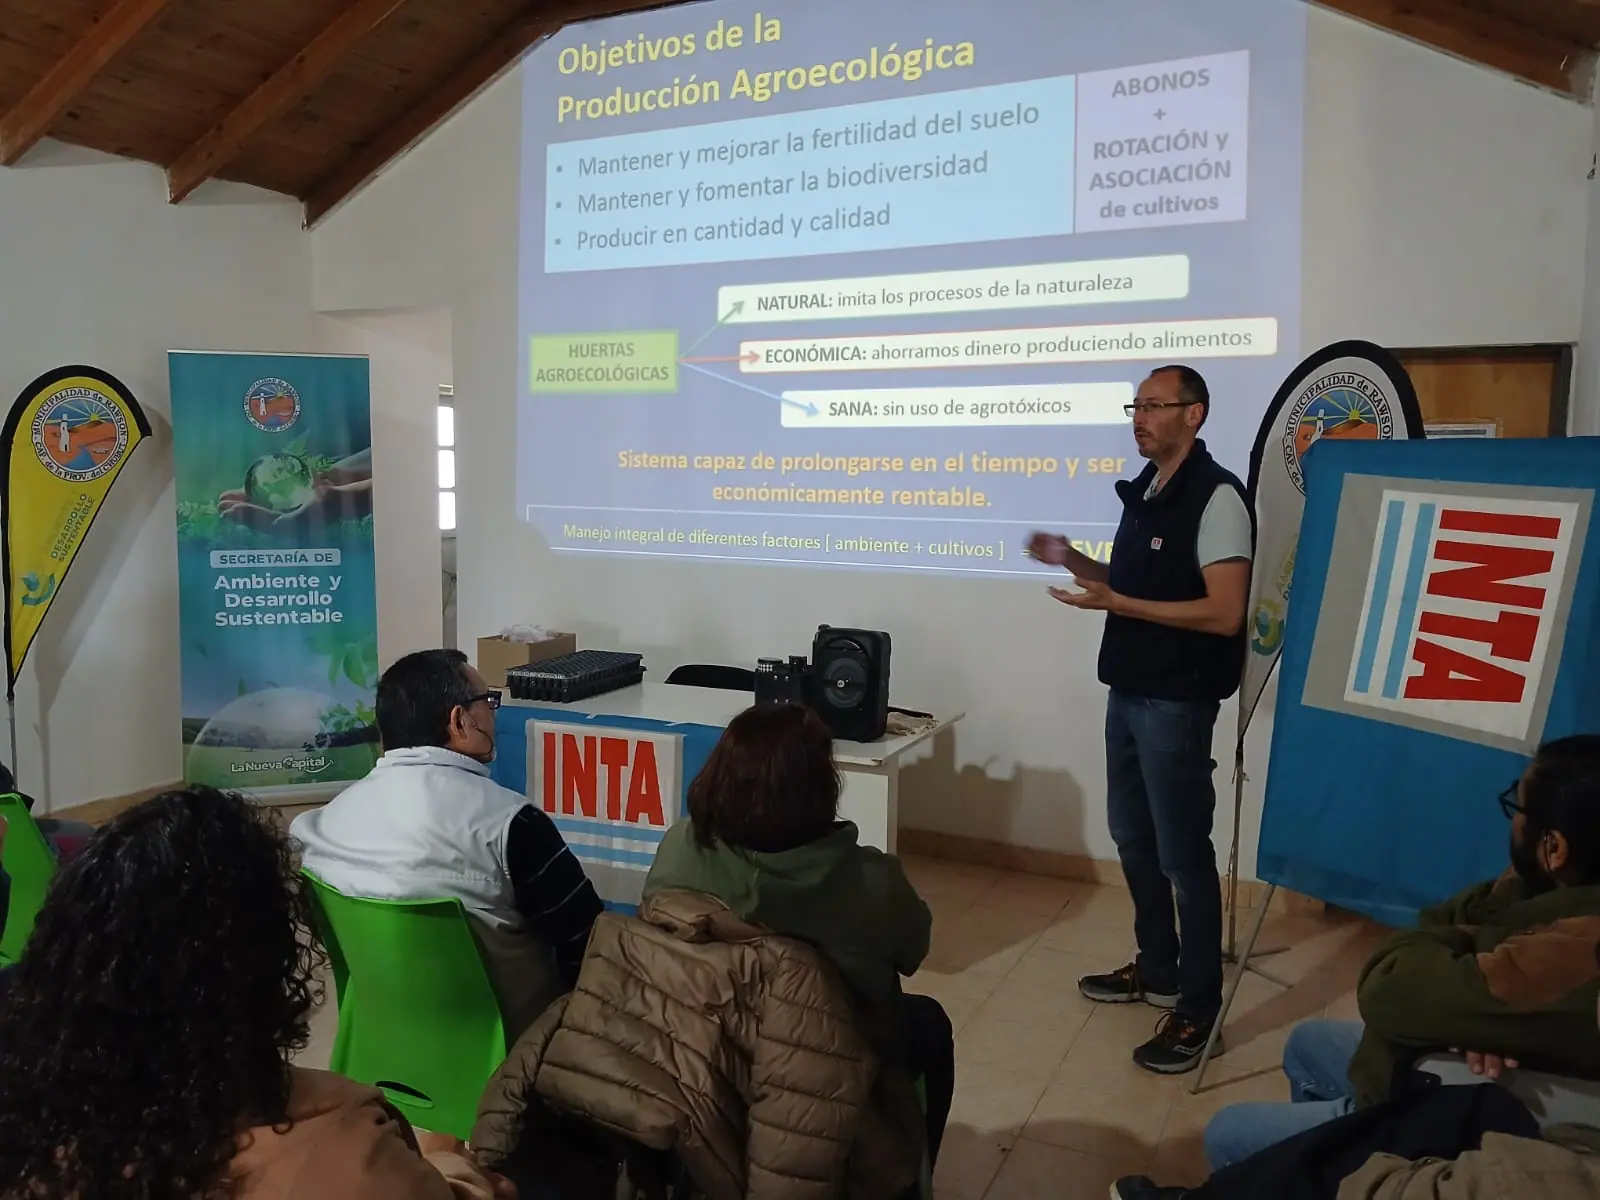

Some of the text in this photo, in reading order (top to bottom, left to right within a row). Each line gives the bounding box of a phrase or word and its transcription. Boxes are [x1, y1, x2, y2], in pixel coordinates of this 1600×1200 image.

[559, 13, 782, 75] Objetivos de la
[558, 38, 975, 122] Producción Agroecológica
[1112, 68, 1210, 98] ABONOS
[578, 103, 1039, 178] Mantener y mejorar la fertilidad del suelo
[1093, 129, 1229, 160] ROTACIÓN y
[578, 150, 988, 214] Mantener y fomentar la biodiversidad
[1089, 159, 1232, 191] ASOCIACIÓN
[1099, 195, 1219, 219] de cultivos
[577, 203, 890, 250] Producir en cantidad y calidad
[757, 274, 1133, 312] NATURAL: imita los procesos de la naturaleza
[568, 342, 635, 360] HUERTAS
[765, 330, 1252, 364] ECONÓMICA: ahorramos dinero produciendo alimentos
[535, 363, 669, 383] AGROECOLÓGICAS
[33, 389, 91, 435] MUNICIPALIDAD
[105, 401, 127, 436] RAWSON
[829, 397, 1071, 419] SANA: sin uso de agrotóxicos
[1287, 375, 1355, 437] MUNICIPALIDAD
[1357, 380, 1369, 391] de
[618, 450, 1126, 478] Sistema capaz de prolongarse en el tiempo y ser
[712, 483, 992, 507] económicamente rentable.
[51, 493, 87, 559] DESARROLLO
[59, 496, 95, 561] SUSTENTABLE
[564, 524, 611, 542] Manejo
[615, 528, 664, 545] integral
[668, 529, 684, 543] de
[688, 530, 757, 547] diferentes
[762, 531, 820, 549] factores
[835, 536, 909, 553] ambiente
[928, 541, 993, 557] cultivos
[219, 551, 333, 565] SECRETARÍA DE
[214, 573, 342, 590] Ambiente y
[225, 591, 332, 608] Desarrollo
[1403, 509, 1561, 703] INTA
[215, 608, 343, 627] Sustentable
[543, 731, 665, 826] INTA
